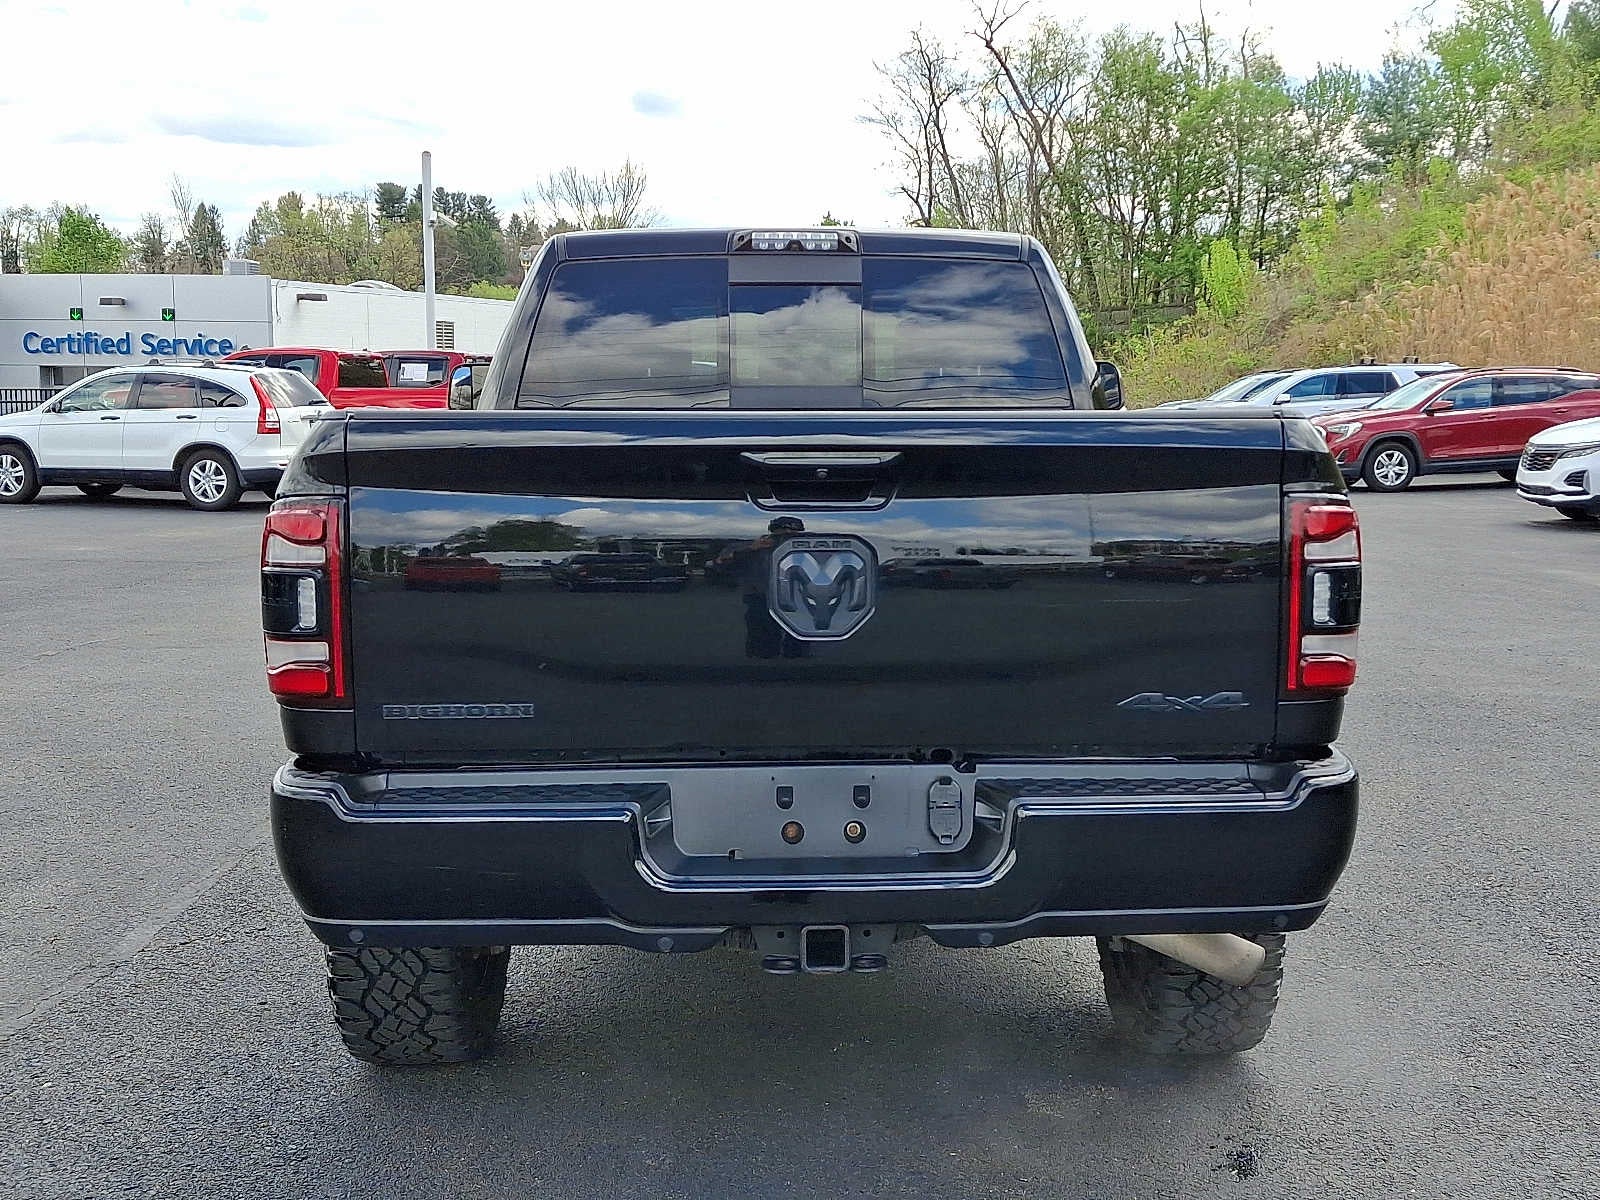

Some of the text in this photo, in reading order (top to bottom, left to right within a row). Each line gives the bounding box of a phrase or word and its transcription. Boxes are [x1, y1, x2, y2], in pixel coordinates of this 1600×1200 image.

[23, 331, 234, 356] Certified Service
[791, 540, 852, 549] RAM
[383, 703, 534, 719] BIGHORN
